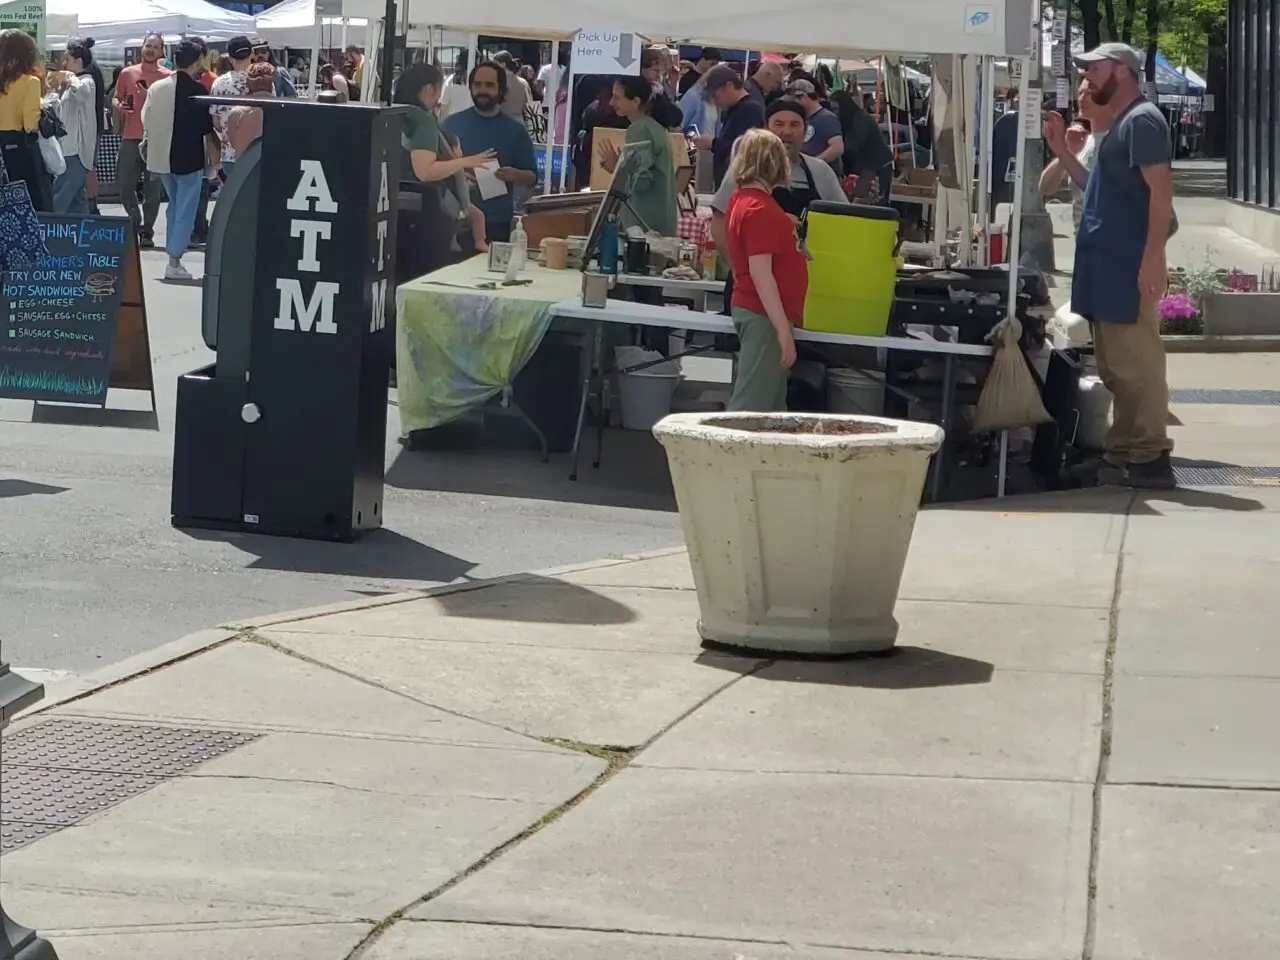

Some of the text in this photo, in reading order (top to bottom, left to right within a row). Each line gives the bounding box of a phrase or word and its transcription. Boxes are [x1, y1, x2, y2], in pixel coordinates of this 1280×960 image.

[15, 12, 27, 20] Fed
[29, 12, 43, 20] Beef
[579, 33, 618, 43] Pick Up
[577, 47, 602, 56] Here
[274, 159, 340, 334] ATM
[370, 162, 390, 333] ATM
[9, 270, 81, 281] TRY OUR NEW
[3, 285, 85, 297] HOT SANDWICHES
[19, 300, 36, 308] EGG
[54, 328, 94, 342] SANDWICH
